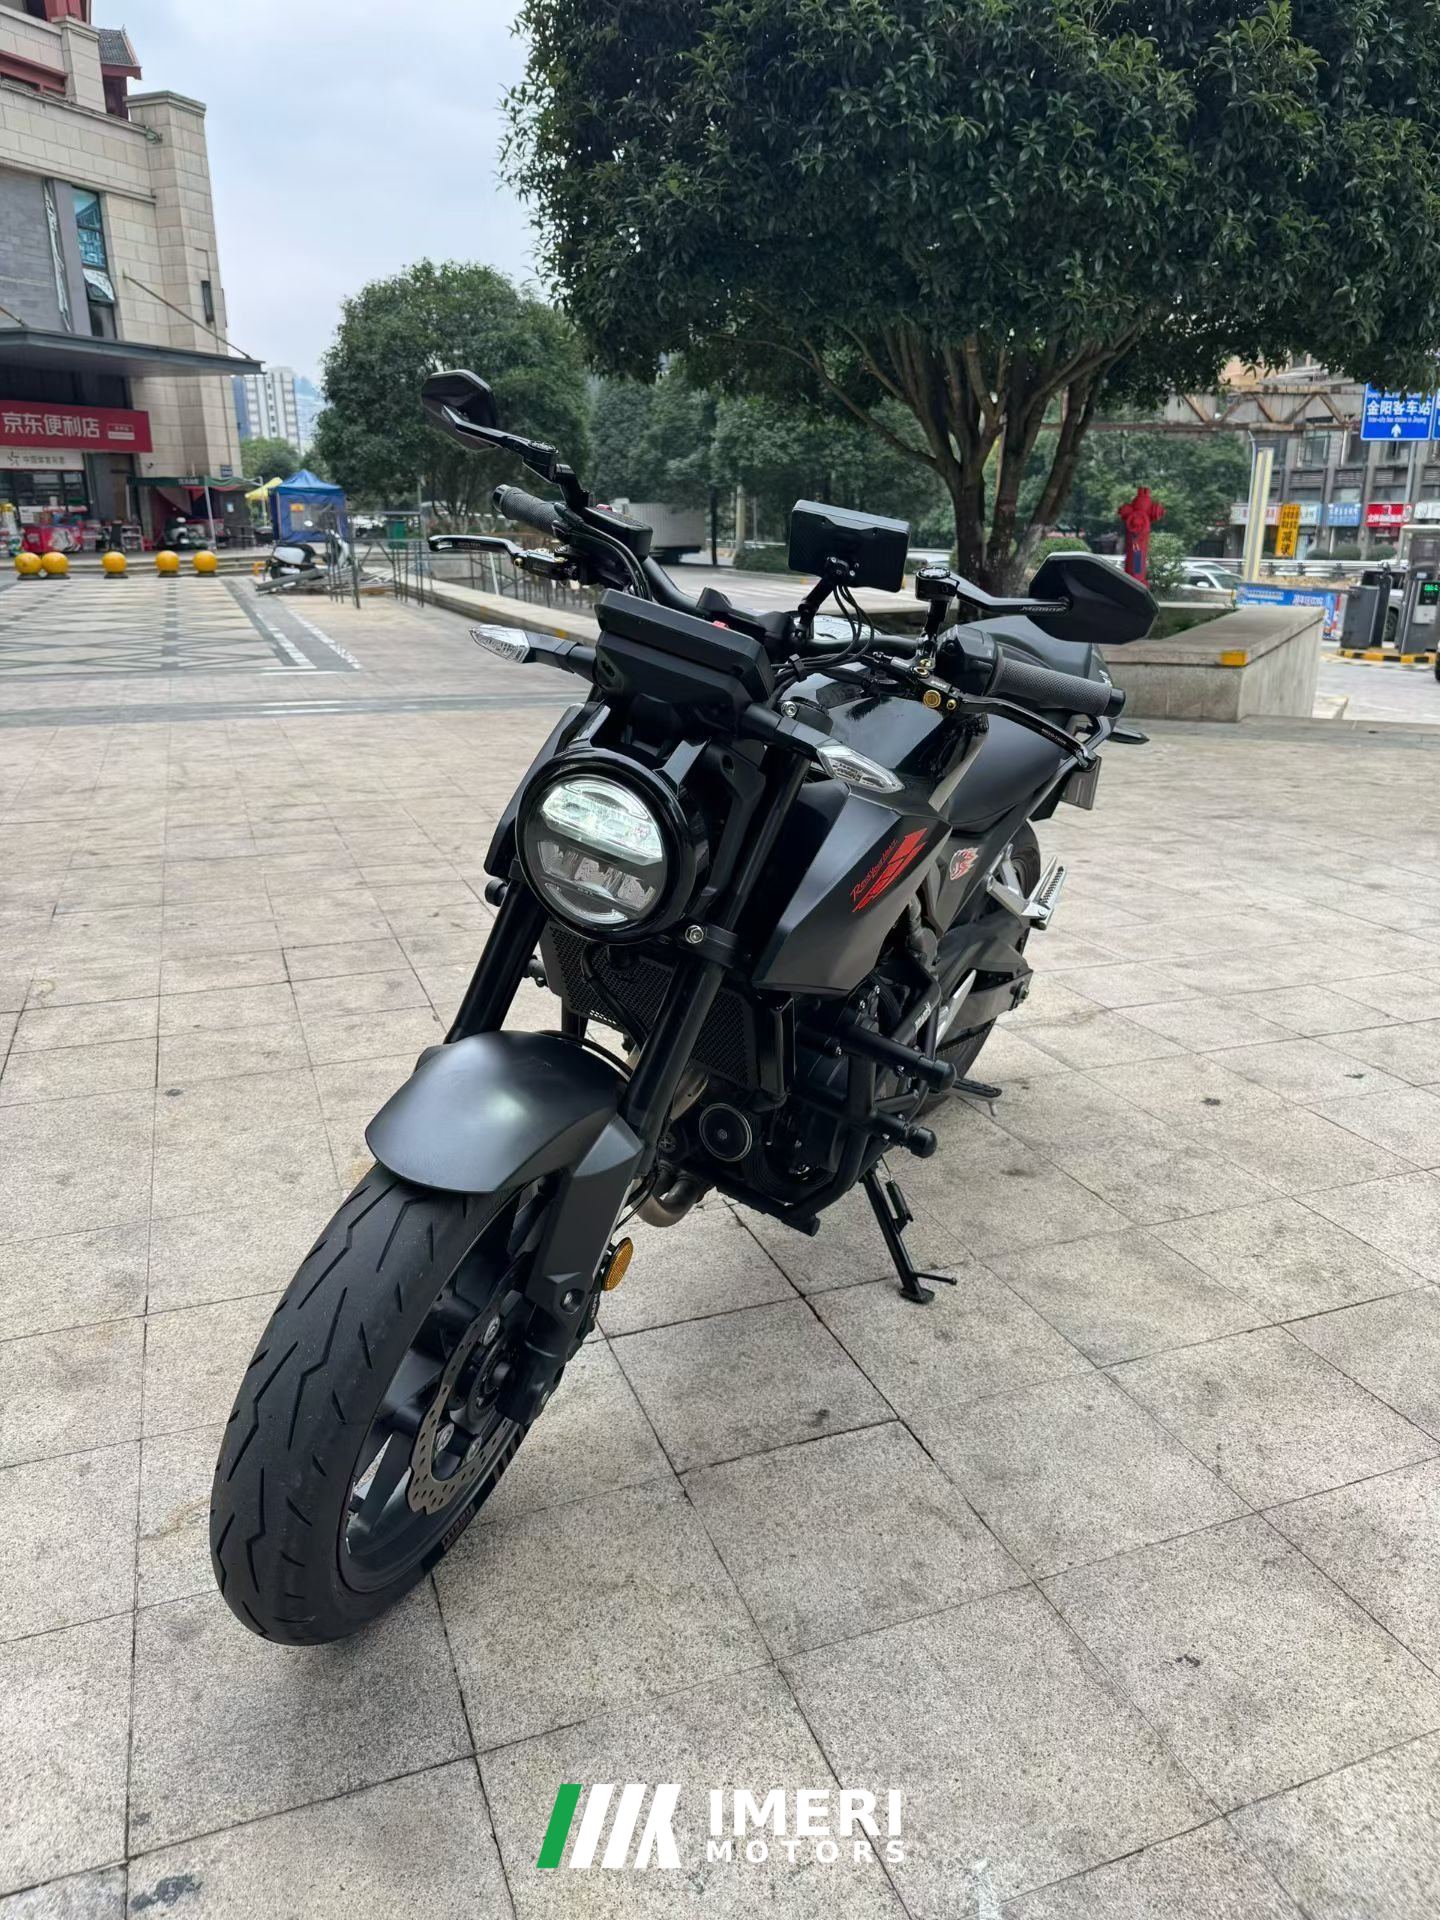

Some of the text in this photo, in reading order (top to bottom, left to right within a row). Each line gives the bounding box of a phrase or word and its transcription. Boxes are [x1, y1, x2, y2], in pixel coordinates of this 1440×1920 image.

[1367, 400, 1431, 416] 金阳客车站
[1, 411, 100, 438] 京东便利店
